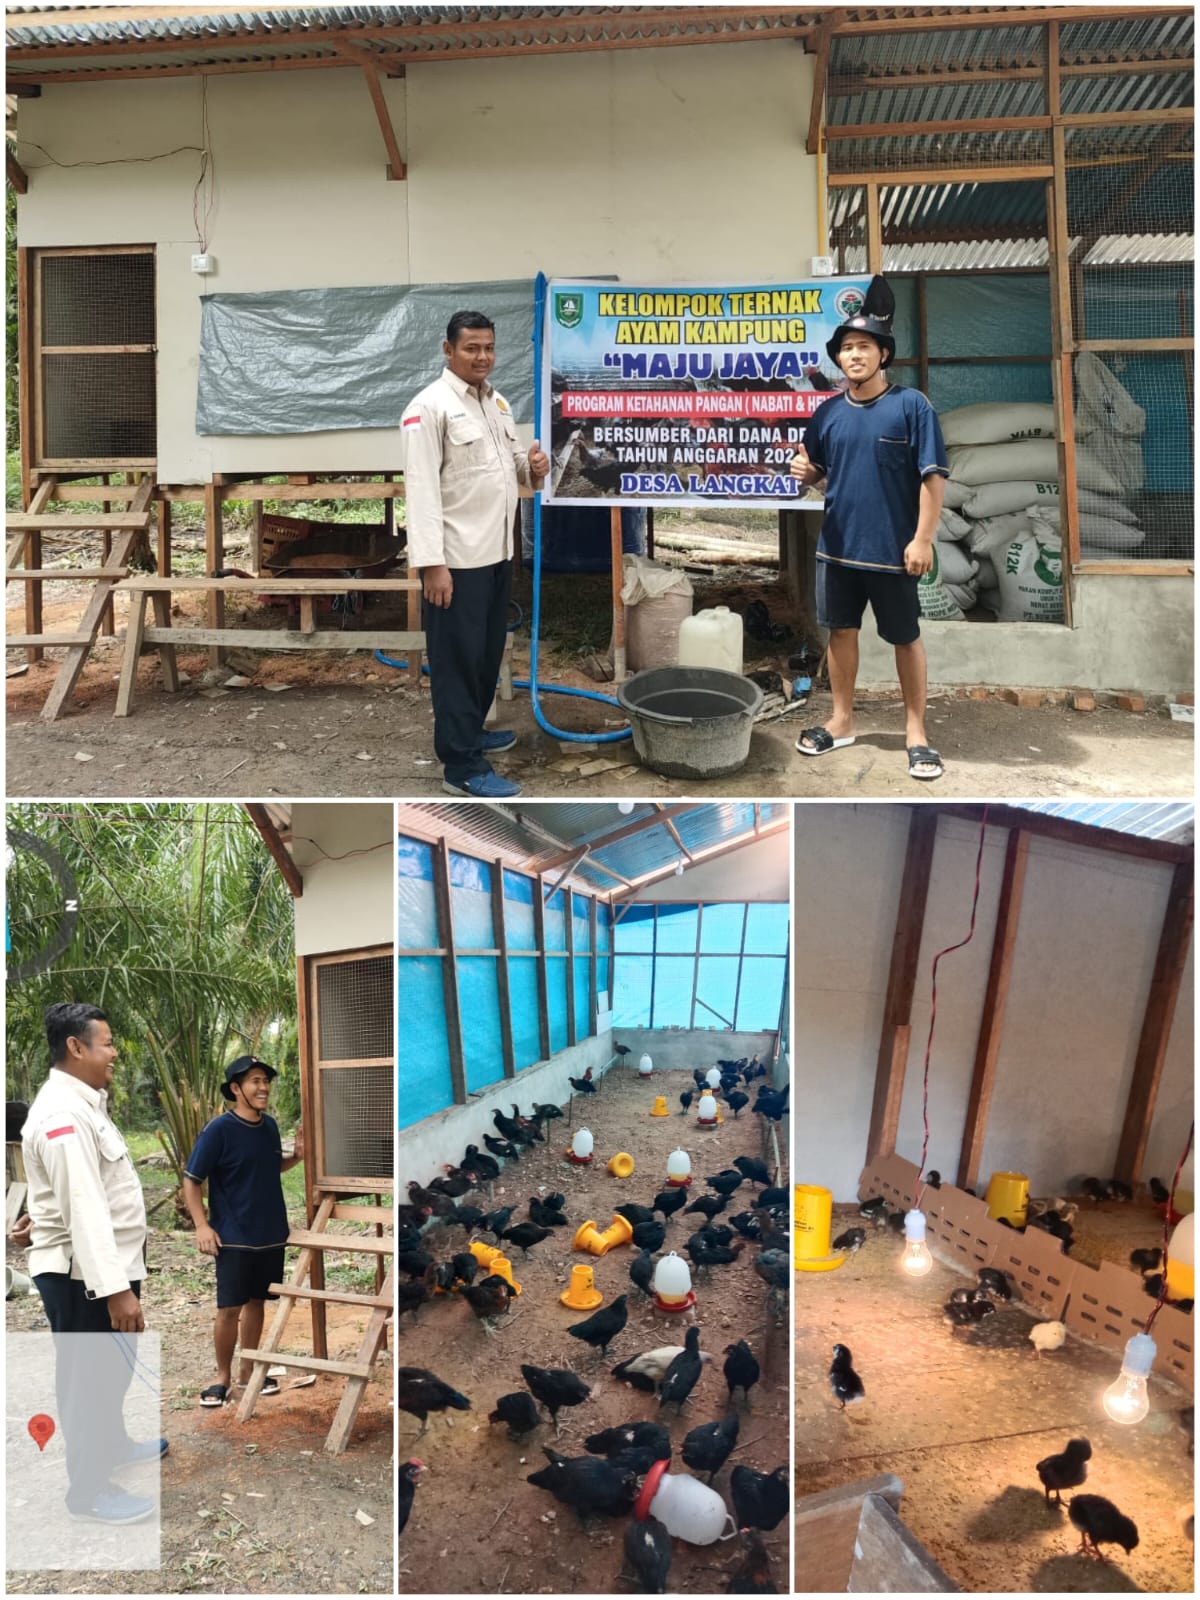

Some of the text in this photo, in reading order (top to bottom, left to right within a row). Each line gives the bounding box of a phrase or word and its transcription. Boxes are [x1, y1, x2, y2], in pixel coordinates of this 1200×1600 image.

[599, 292, 725, 317] KELOMPOK
[728, 289, 823, 316] TERNAK
[615, 318, 806, 345] AYAM KAMPUNG
[603, 351, 819, 379] “MAJU JAYA”
[567, 394, 624, 412] PROGRAM
[626, 394, 693, 412] KETAHANAN
[695, 395, 743, 412] PANGAN
[752, 395, 793, 412] NABATI
[796, 395, 805, 412] &
[808, 395, 830, 412] HE
[593, 426, 807, 443] BERSUMBER DARI DANA DE
[616, 447, 795, 464] TAHUN ANGGARAN 202
[621, 474, 802, 495] DESA LANGKAT
[1036, 483, 1060, 496] B12
[1006, 542, 1023, 576] B12K
